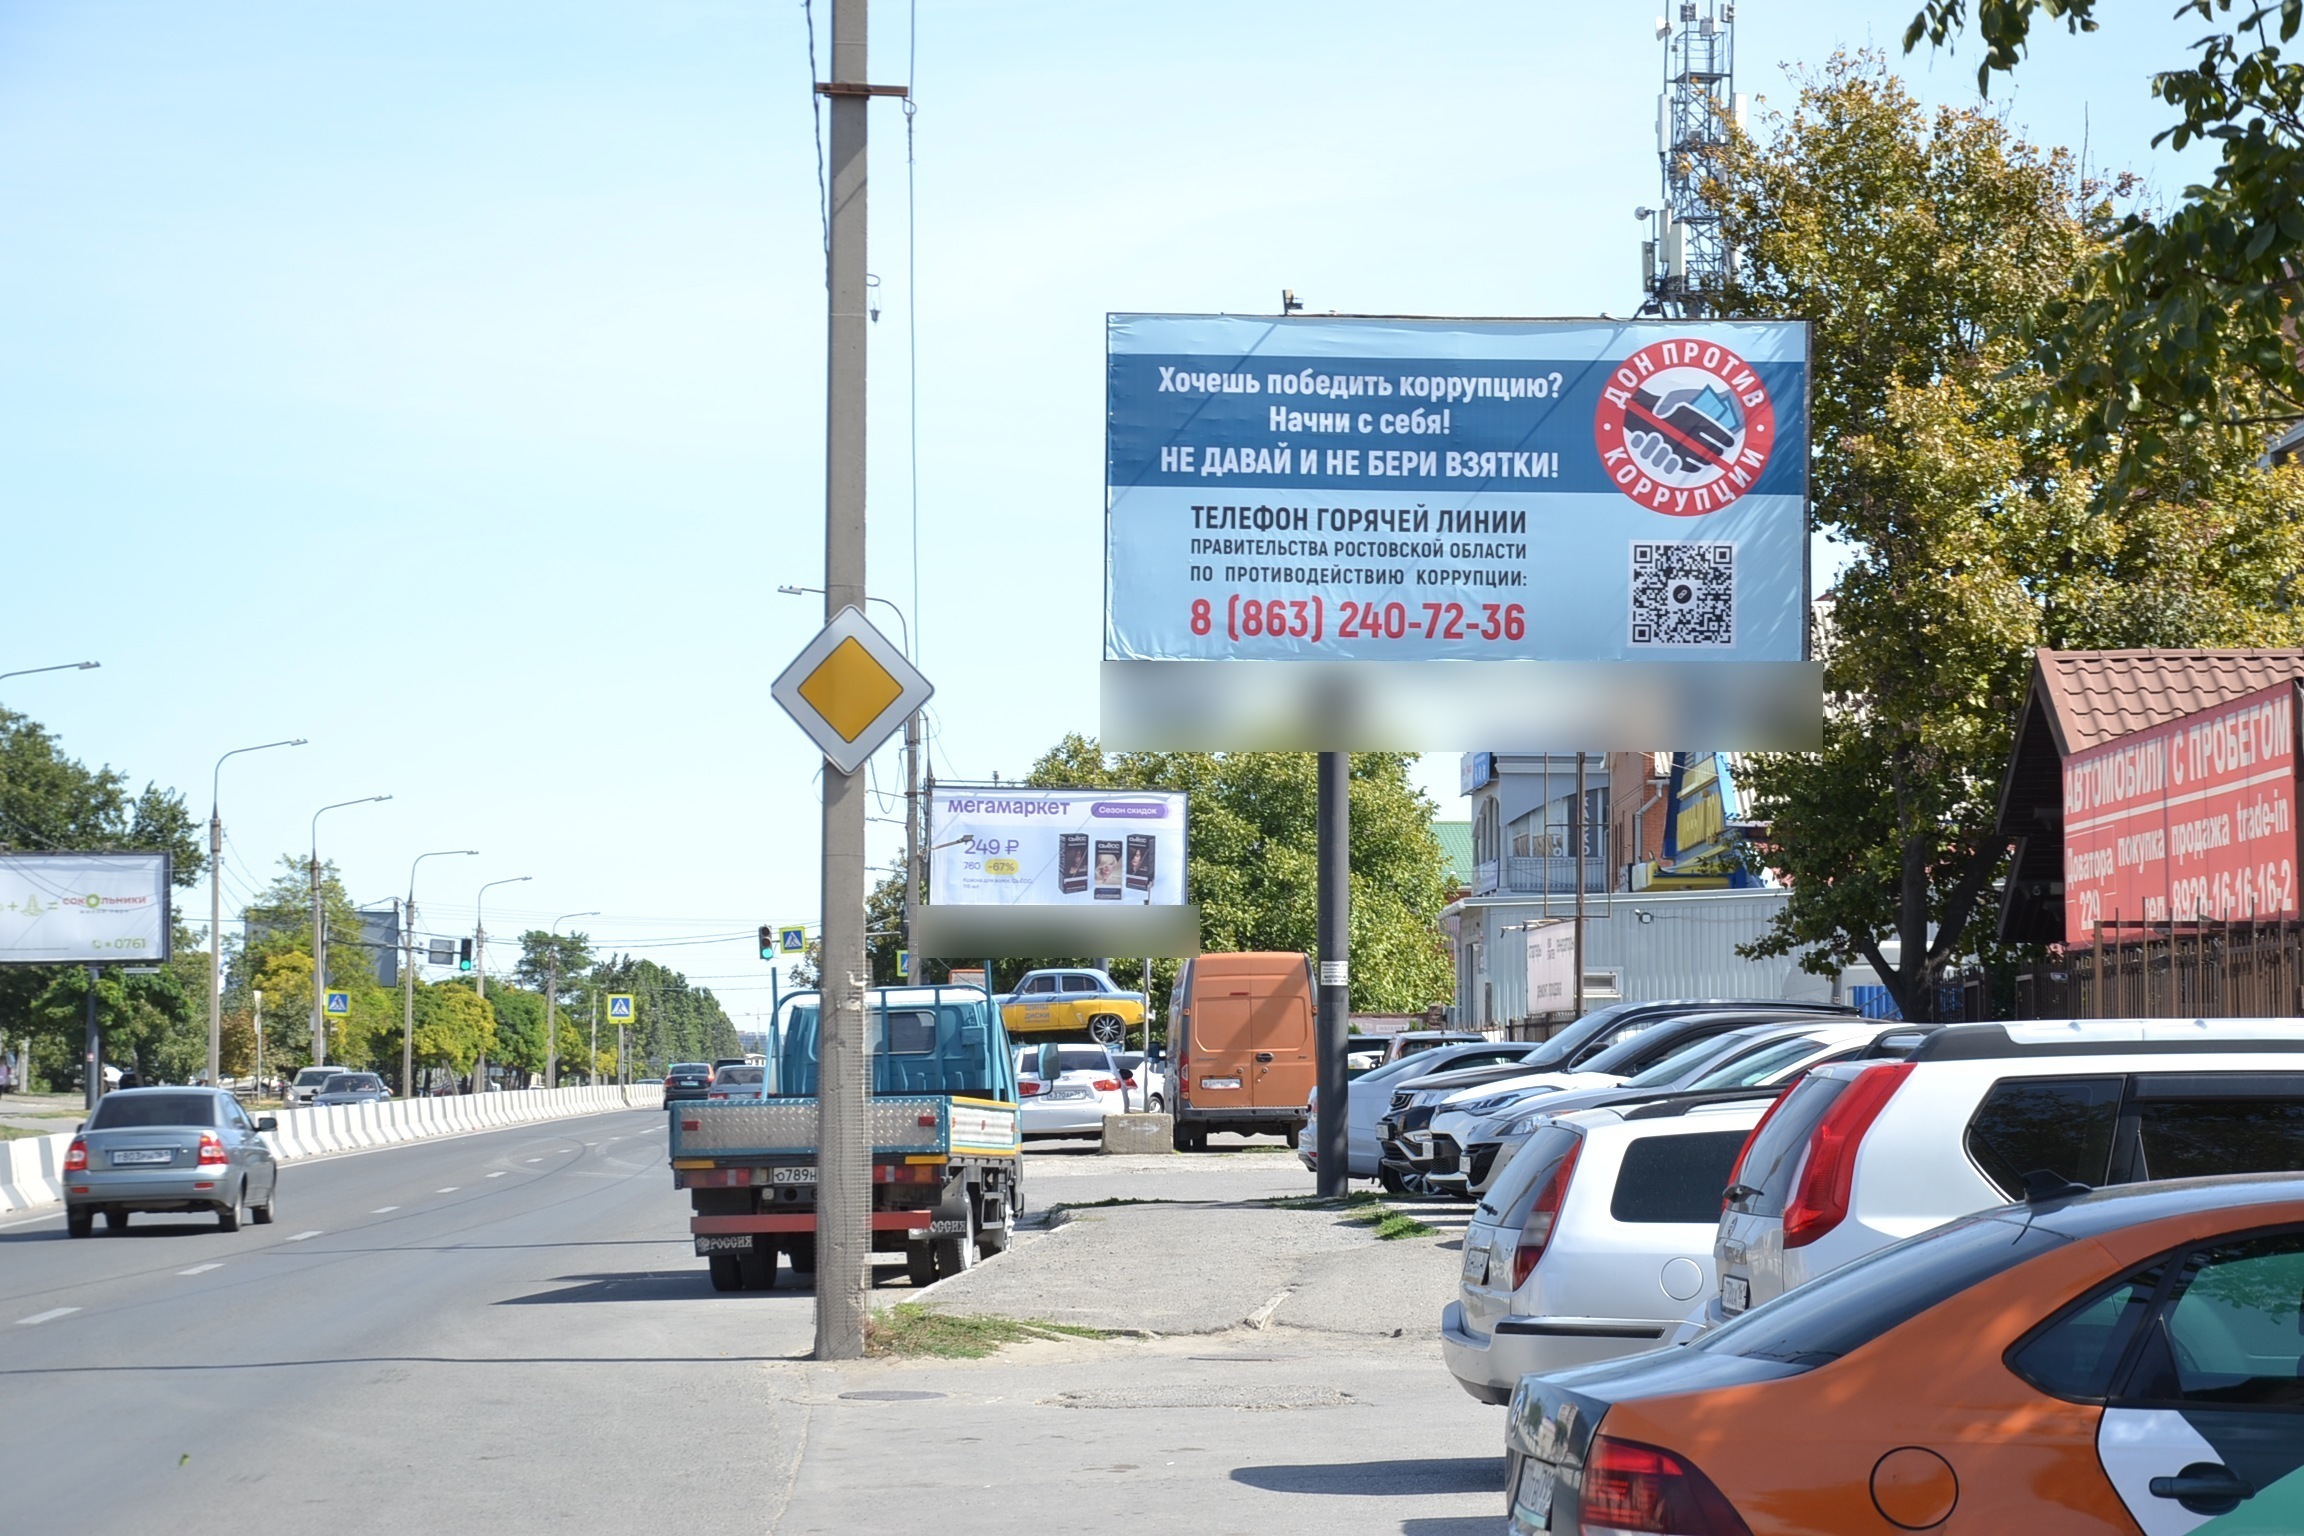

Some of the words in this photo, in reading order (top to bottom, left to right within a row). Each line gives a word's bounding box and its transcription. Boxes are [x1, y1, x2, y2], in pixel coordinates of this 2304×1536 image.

[1158, 366, 1261, 393] Хочешь
[1267, 367, 1393, 400] победить
[1400, 372, 1564, 404] коррупцию?
[1604, 352, 1655, 410] ДОН
[1661, 342, 1765, 408] ПРОТИВ
[1269, 405, 1350, 433] Начни
[1358, 412, 1374, 434] с
[1379, 407, 1451, 435] себя!
[1160, 446, 1195, 473] НЕ
[1200, 441, 1292, 477] ДАВАЙ
[1300, 448, 1318, 475] И
[1326, 449, 1361, 476] НЕ
[1367, 450, 1437, 477] БЕРИ
[1445, 450, 1559, 478] ВЗЯТКИ!
[1604, 446, 1765, 513] КОРРУПЦИИ
[1190, 505, 1308, 532] ТЕЛЕФОН
[1317, 503, 1429, 533] ГОРЯЧЕЙ
[1436, 510, 1526, 534] ЛИНИИ
[1190, 538, 1329, 556] ПРАВИТЕЛЬСТВА
[1334, 538, 1444, 559] РОСТОВСКОЙ
[1449, 542, 1527, 560] ОБЛАСТИ
[1190, 565, 1213, 582] ПО
[1225, 564, 1404, 586] ПРОТИВОДЕЙСТВИЮ
[1416, 569, 1528, 589] КОРРУПЦИИ:
[1190, 598, 1212, 636] 8
[1227, 593, 1323, 643] (863)
[1338, 600, 1525, 641] 240-72-36
[2064, 735, 2168, 815] АВТОМОБИЛИ
[2172, 729, 2185, 786] С
[2189, 694, 2291, 782] ПРОБЕГОМ
[948, 800, 1070, 818] мегамаркет
[1098, 806, 1125, 815] Сезон
[1126, 807, 1158, 816] скидок
[964, 838, 1000, 855] 249
[2117, 829, 2165, 874] покупка
[2171, 813, 2230, 865] продажа
[2236, 789, 2289, 843] trade-in
[988, 862, 1015, 872] -67%
[2066, 847, 2114, 891] Доватора
[2173, 858, 2293, 922] 8928-16-16-16-2
[2080, 889, 2100, 931] 229
[710, 1235, 753, 1250] РОССИЯ
[924, 1220, 966, 1233] ОССИЯ
